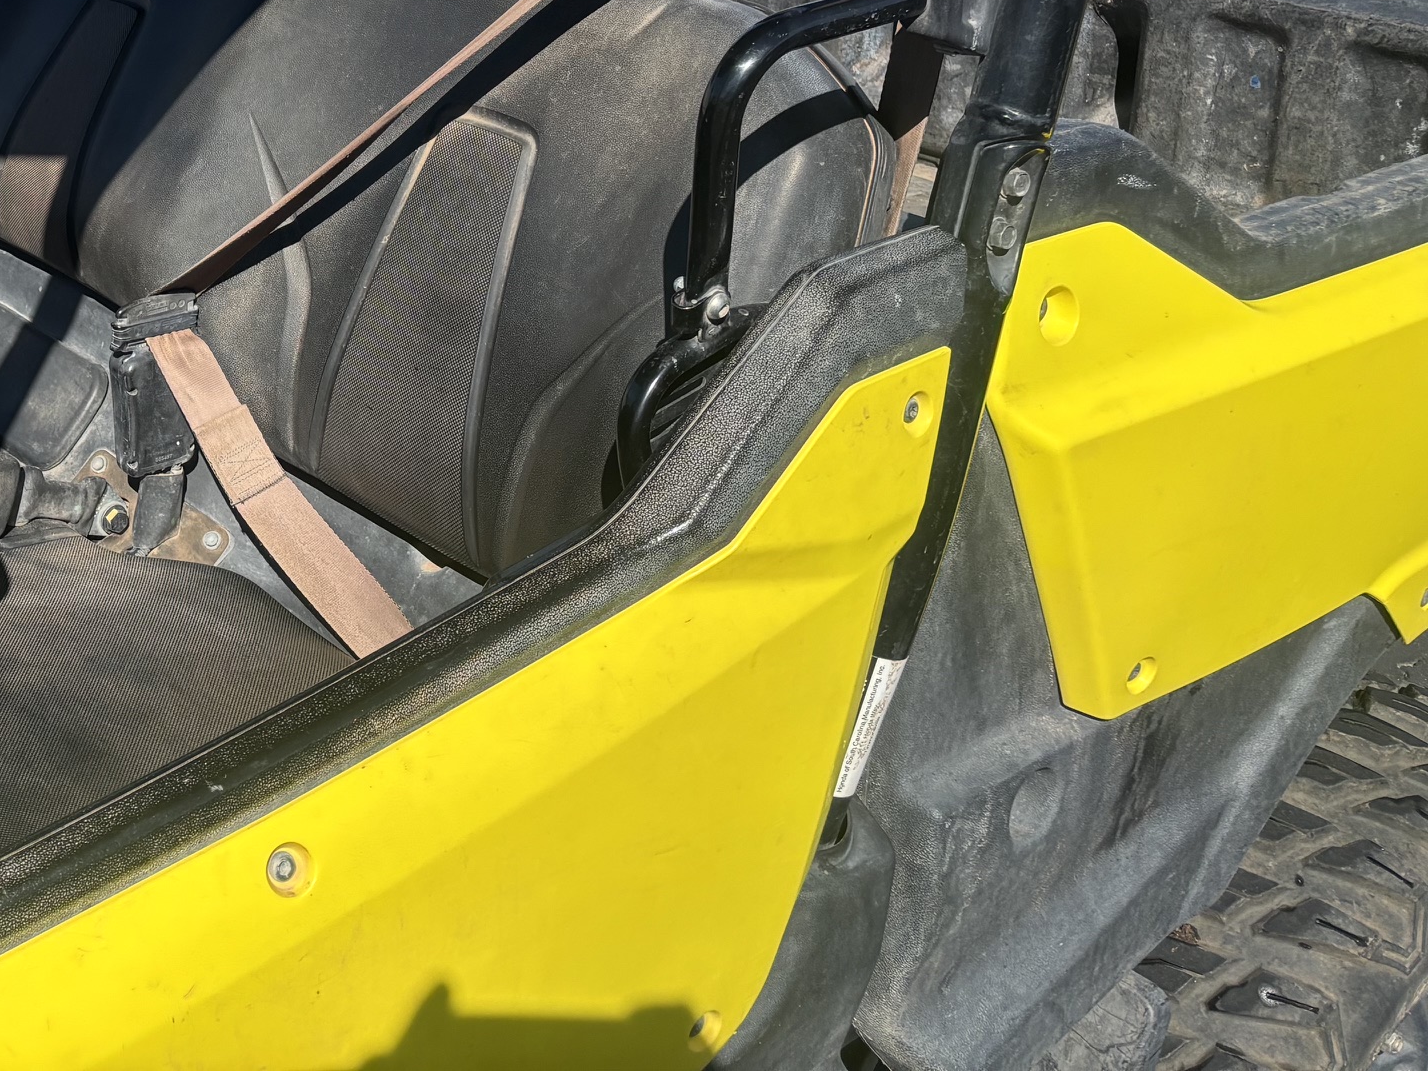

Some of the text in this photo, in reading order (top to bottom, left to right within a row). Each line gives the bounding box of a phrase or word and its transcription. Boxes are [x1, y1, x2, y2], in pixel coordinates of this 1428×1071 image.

[837, 773, 848, 793] Honda
[846, 746, 857, 766] South
[852, 721, 866, 747] Carolina
[861, 676, 882, 721] Manufacturing,
[877, 664, 886, 676] Inc.
